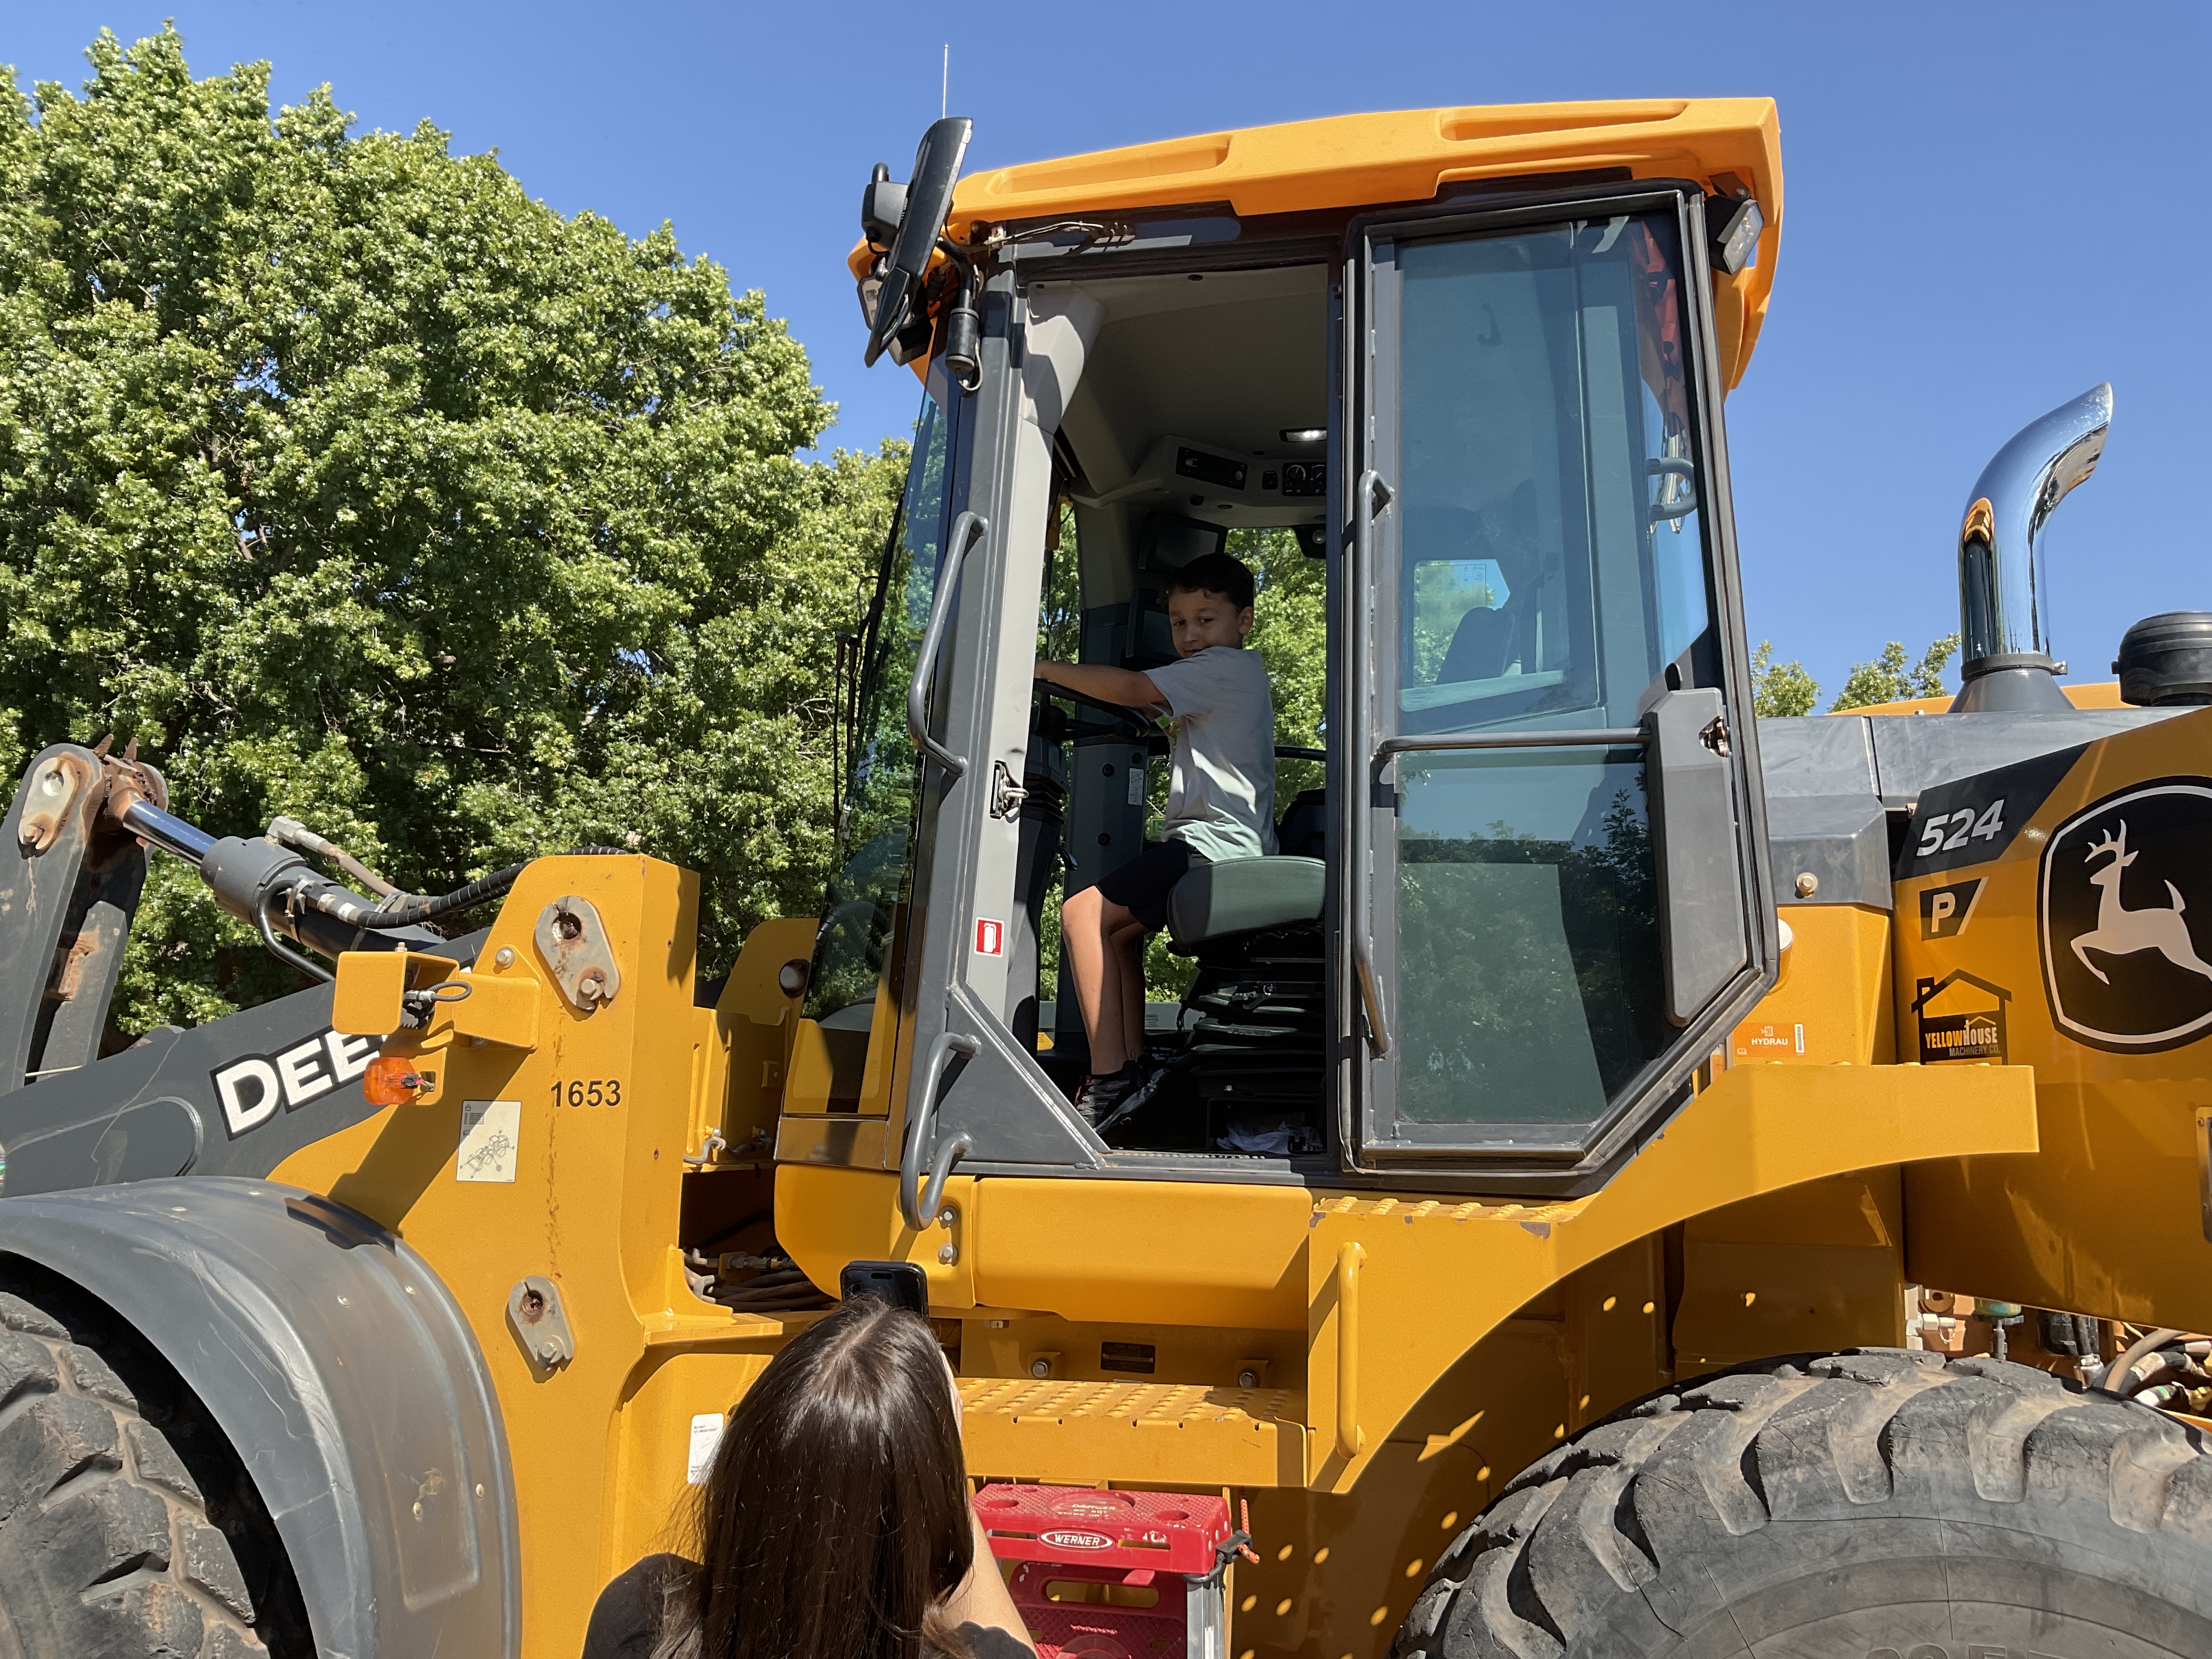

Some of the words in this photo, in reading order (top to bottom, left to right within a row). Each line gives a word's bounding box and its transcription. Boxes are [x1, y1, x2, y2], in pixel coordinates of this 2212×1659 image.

[1916, 799, 2004, 856] 524
[1931, 892, 1956, 933] P
[1949, 1046, 1987, 1057] MACHINERY
[1989, 1044, 2000, 1054] CO.
[216, 1030, 388, 1133] DEE
[551, 1080, 621, 1107] 1653
[1054, 1533, 1101, 1546] WERNER
